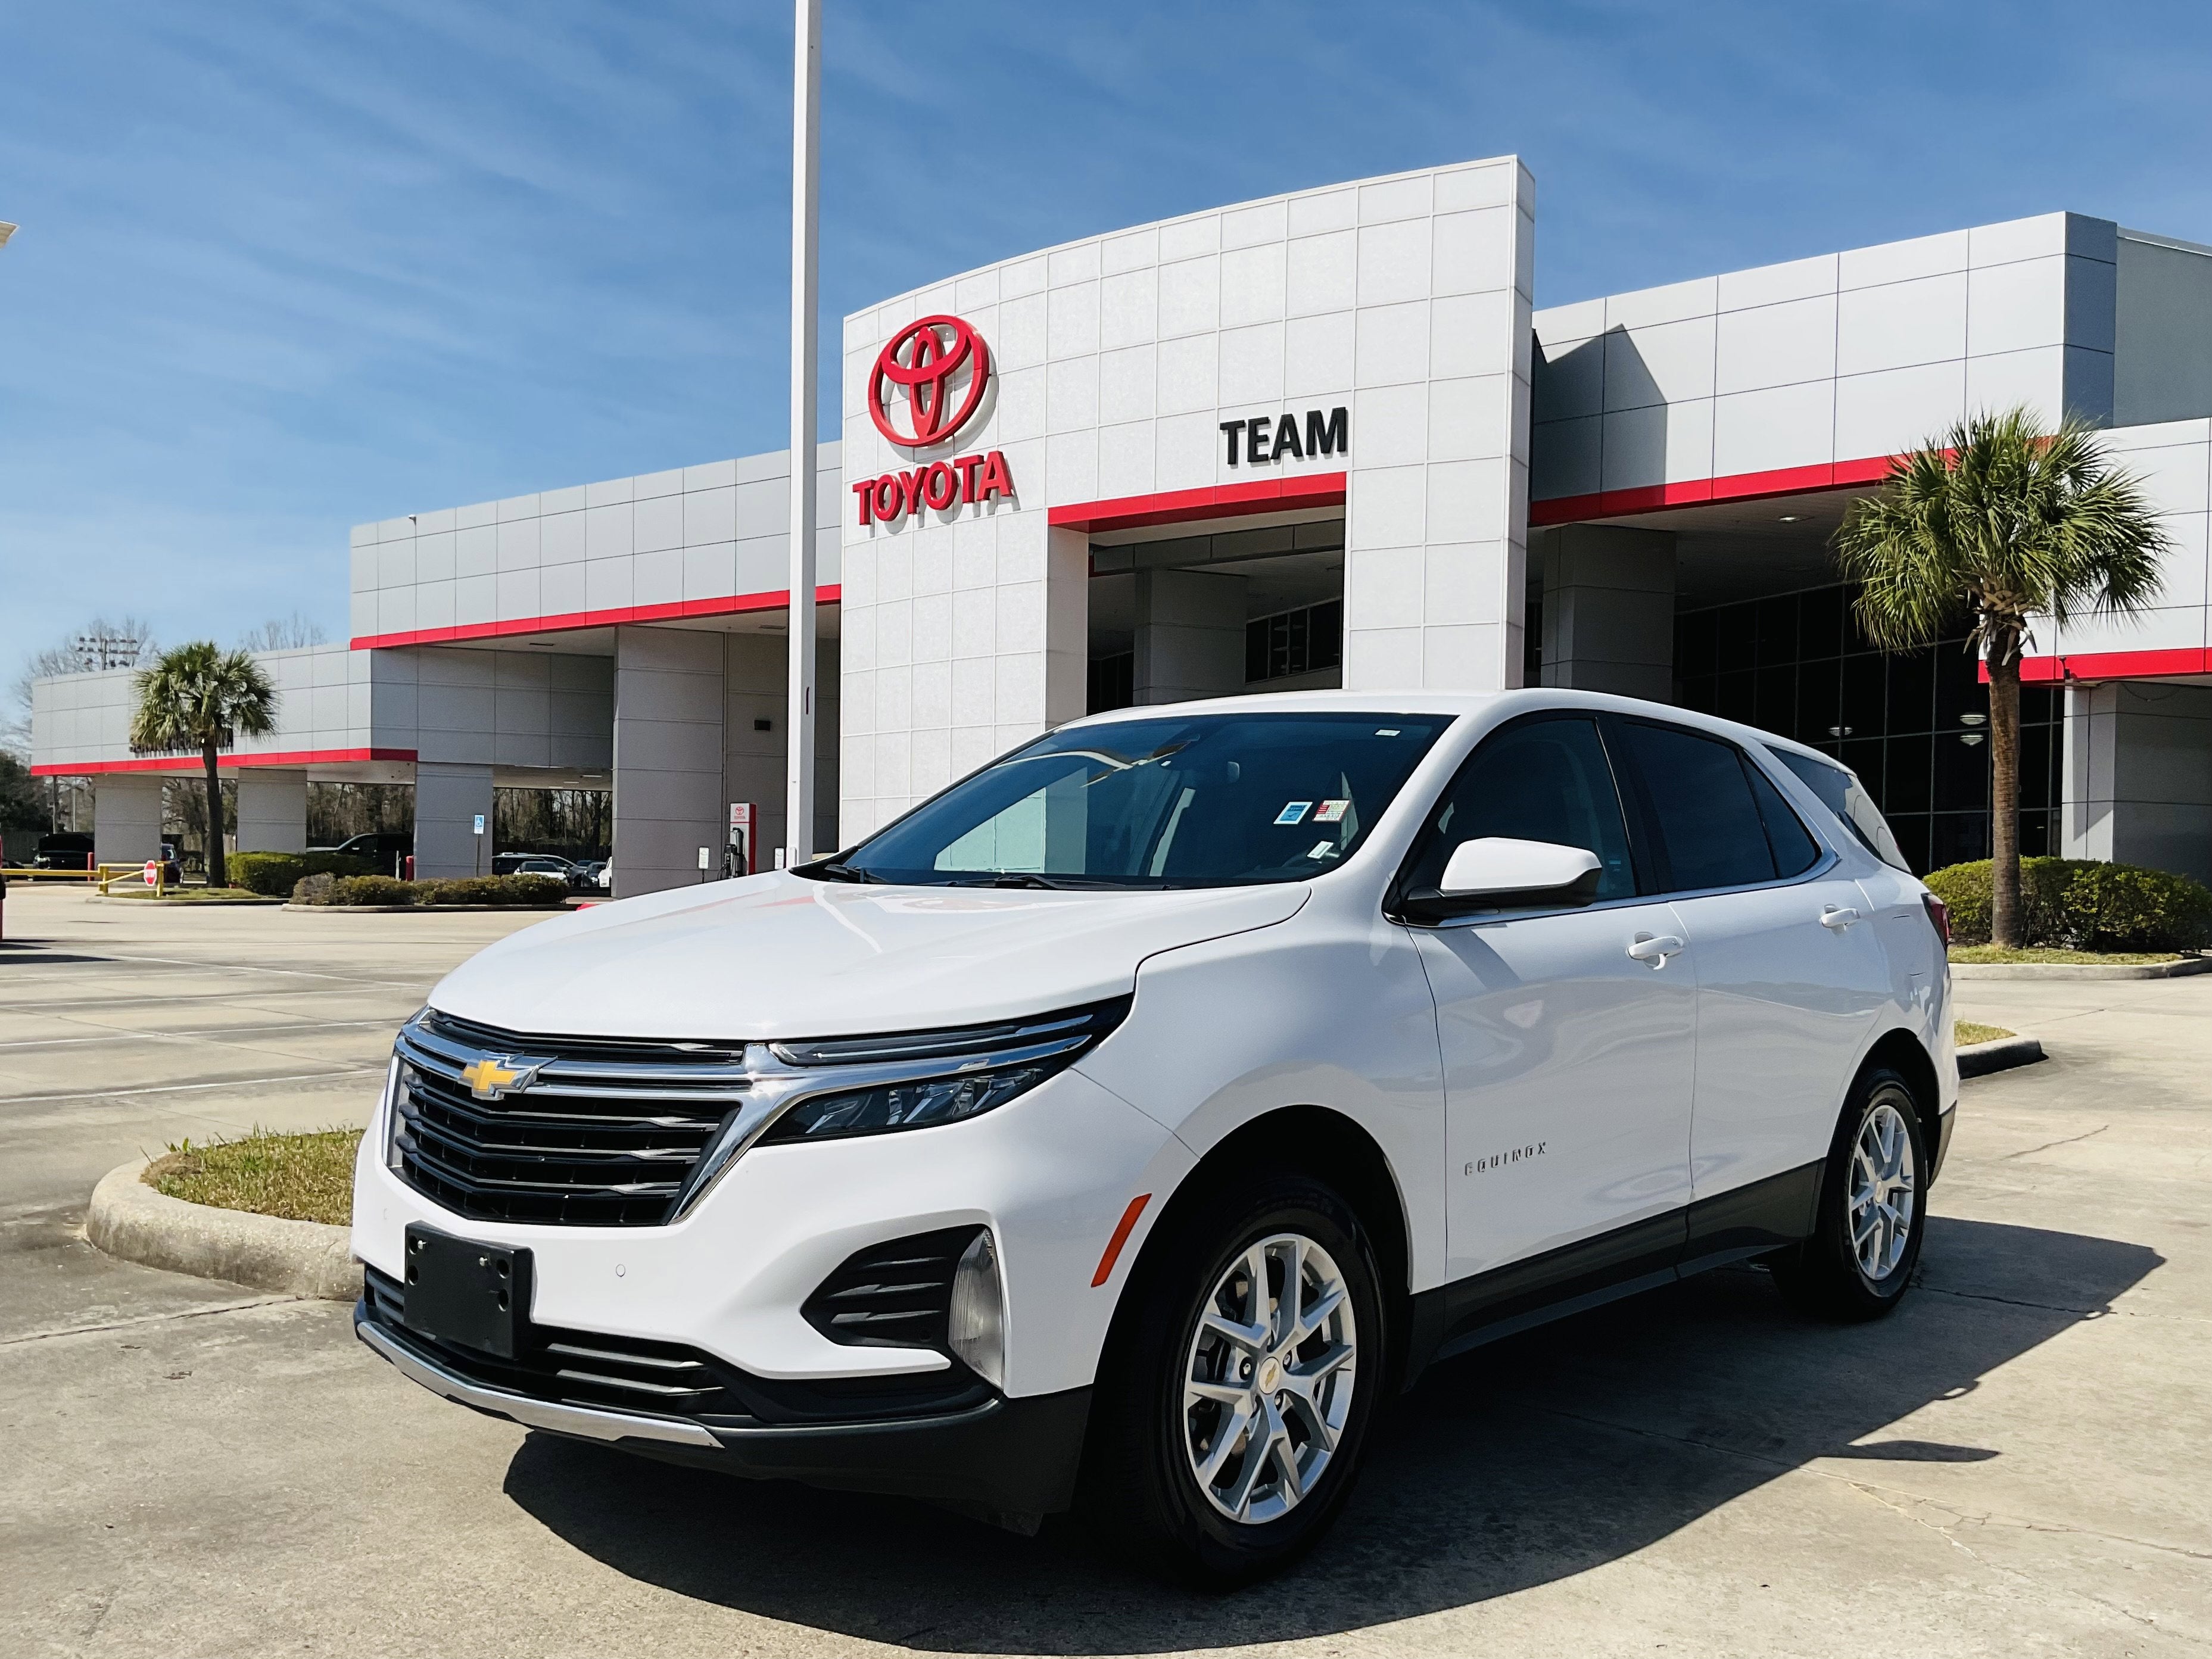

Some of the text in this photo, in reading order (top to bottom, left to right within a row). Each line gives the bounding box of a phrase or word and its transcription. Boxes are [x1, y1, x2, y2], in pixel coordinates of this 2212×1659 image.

[1220, 407, 1346, 464] TEAM
[852, 451, 1014, 525] TOYOTA
[1465, 1142, 1546, 1175] EQUINOX
